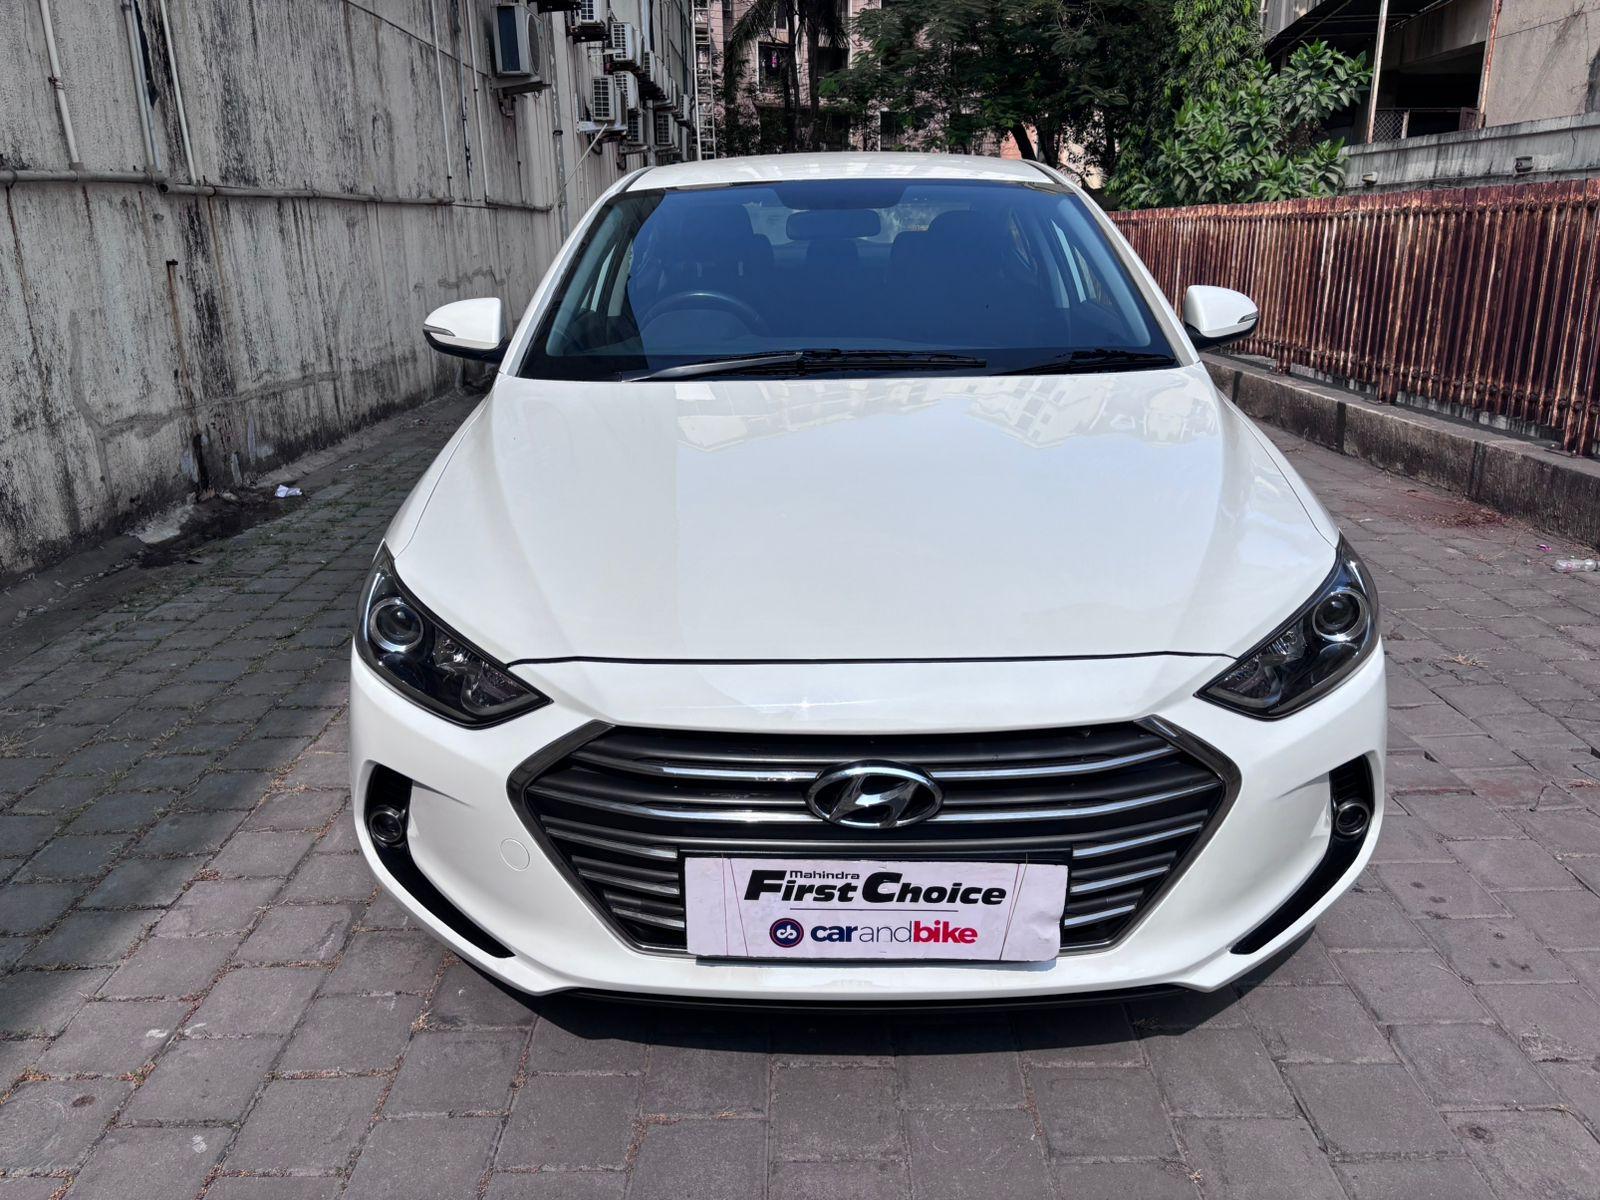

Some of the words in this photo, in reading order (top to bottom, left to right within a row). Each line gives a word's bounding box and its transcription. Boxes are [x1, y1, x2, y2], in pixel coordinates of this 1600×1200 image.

[743, 869, 859, 903] First
[861, 872, 1007, 905] Choice
[789, 870, 861, 880] Mahindra
[810, 920, 979, 944] carandbike
